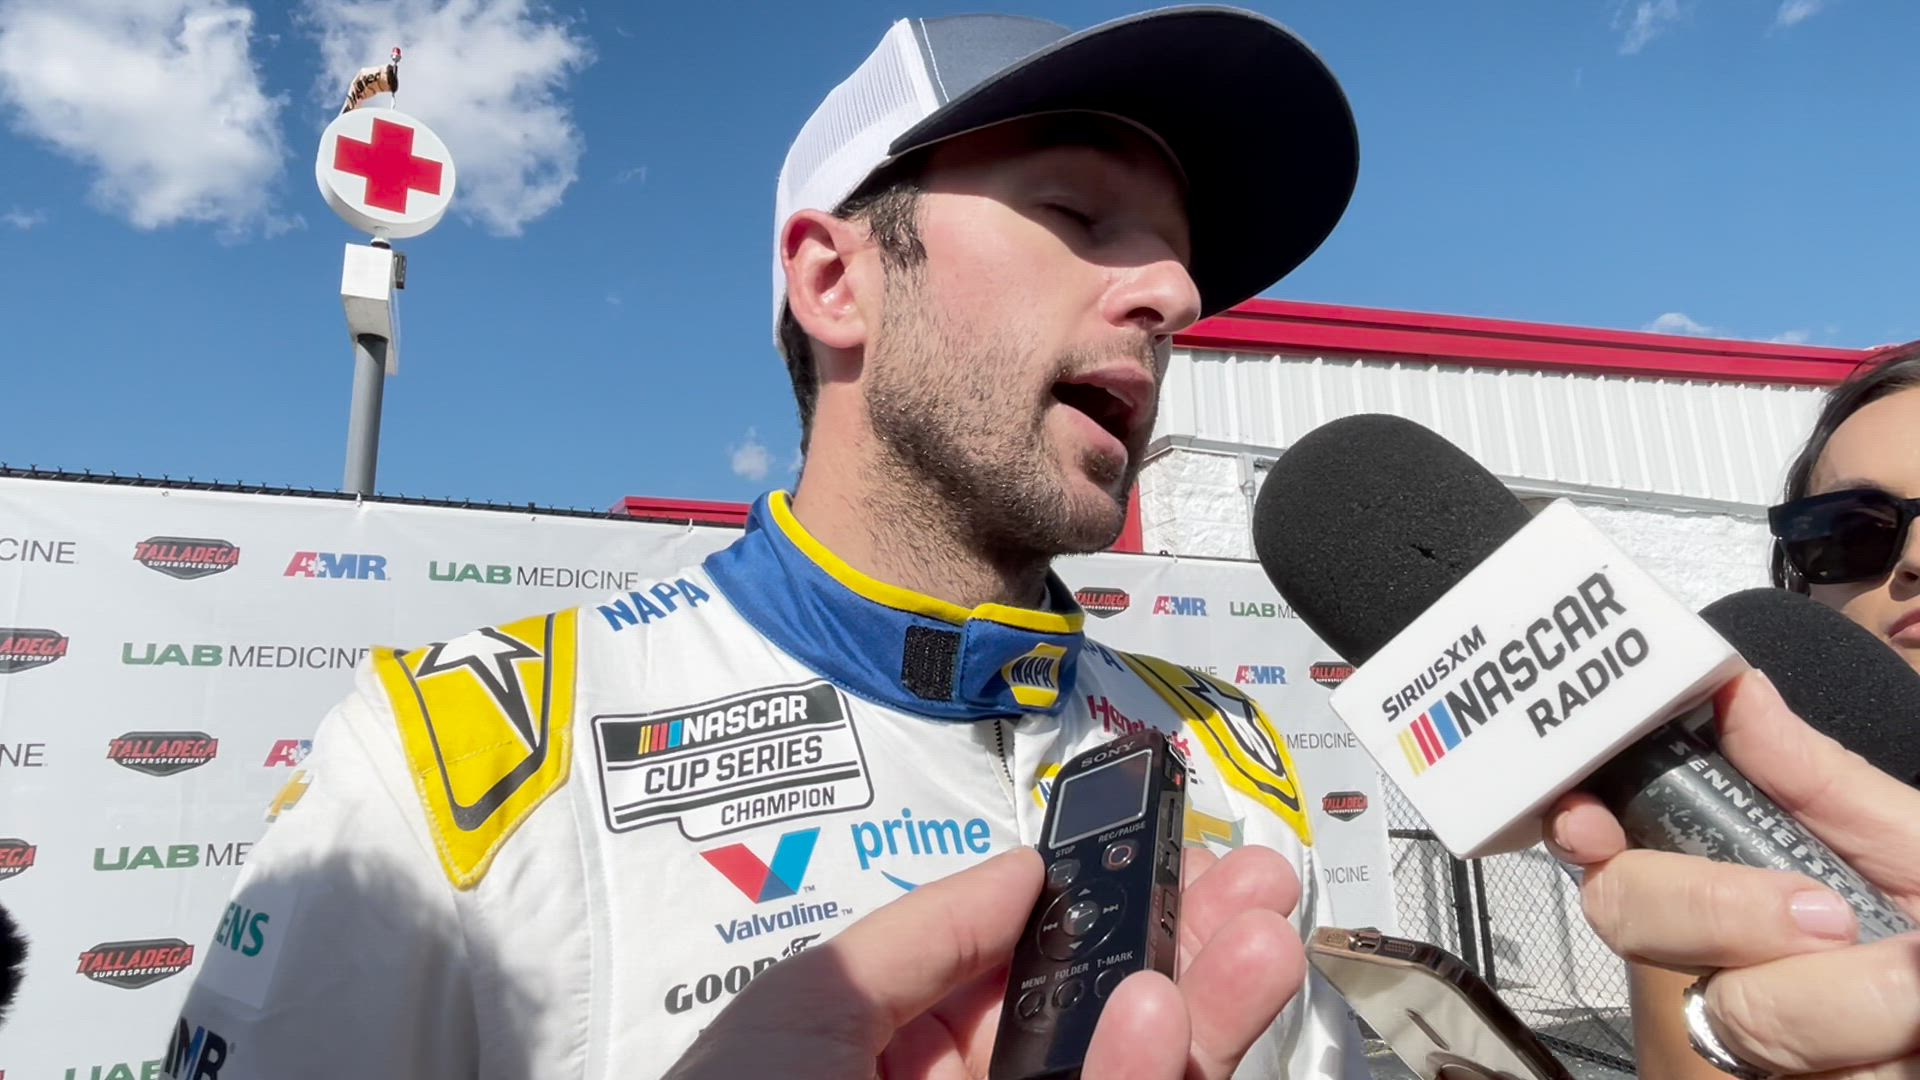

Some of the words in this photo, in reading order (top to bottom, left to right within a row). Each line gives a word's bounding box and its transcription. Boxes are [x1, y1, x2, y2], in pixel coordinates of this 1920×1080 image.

[133, 542, 240, 565] TALLADEGA
[283, 551, 386, 580] AMR
[429, 561, 512, 585] UAB
[517, 567, 638, 591] MEDICINE
[595, 577, 710, 632] NAPA
[1153, 596, 1207, 616] AMR
[1230, 601, 1275, 617] UAB
[122, 643, 223, 667] UAB
[1445, 572, 1627, 738] NASCAR
[1011, 656, 1056, 689] NAPA
[1235, 665, 1286, 685] AMR
[1382, 624, 1487, 722] SIRIUSXM
[1526, 628, 1649, 738] RADIO
[681, 694, 808, 744] NASCAR
[107, 738, 218, 758] TALLADEGA
[1081, 741, 1136, 768] SONY
[1287, 733, 1357, 749] MEDICINE
[645, 760, 709, 795] CUP
[716, 735, 823, 783] SERIES
[721, 785, 836, 827] CHAMPION
[850, 808, 991, 870] prime
[1055, 845, 1076, 858] STOP
[1098, 821, 1147, 843] REC/PAUSE
[93, 844, 200, 871] UAB
[714, 900, 838, 944] Valvoline
[77, 945, 194, 974] TALLADEGA
[93, 966, 180, 978] SUPERSPEEDWAY
[1021, 975, 1047, 989] MENU
[1054, 963, 1089, 979] FOLDER
[1096, 951, 1134, 968] T-MARK
